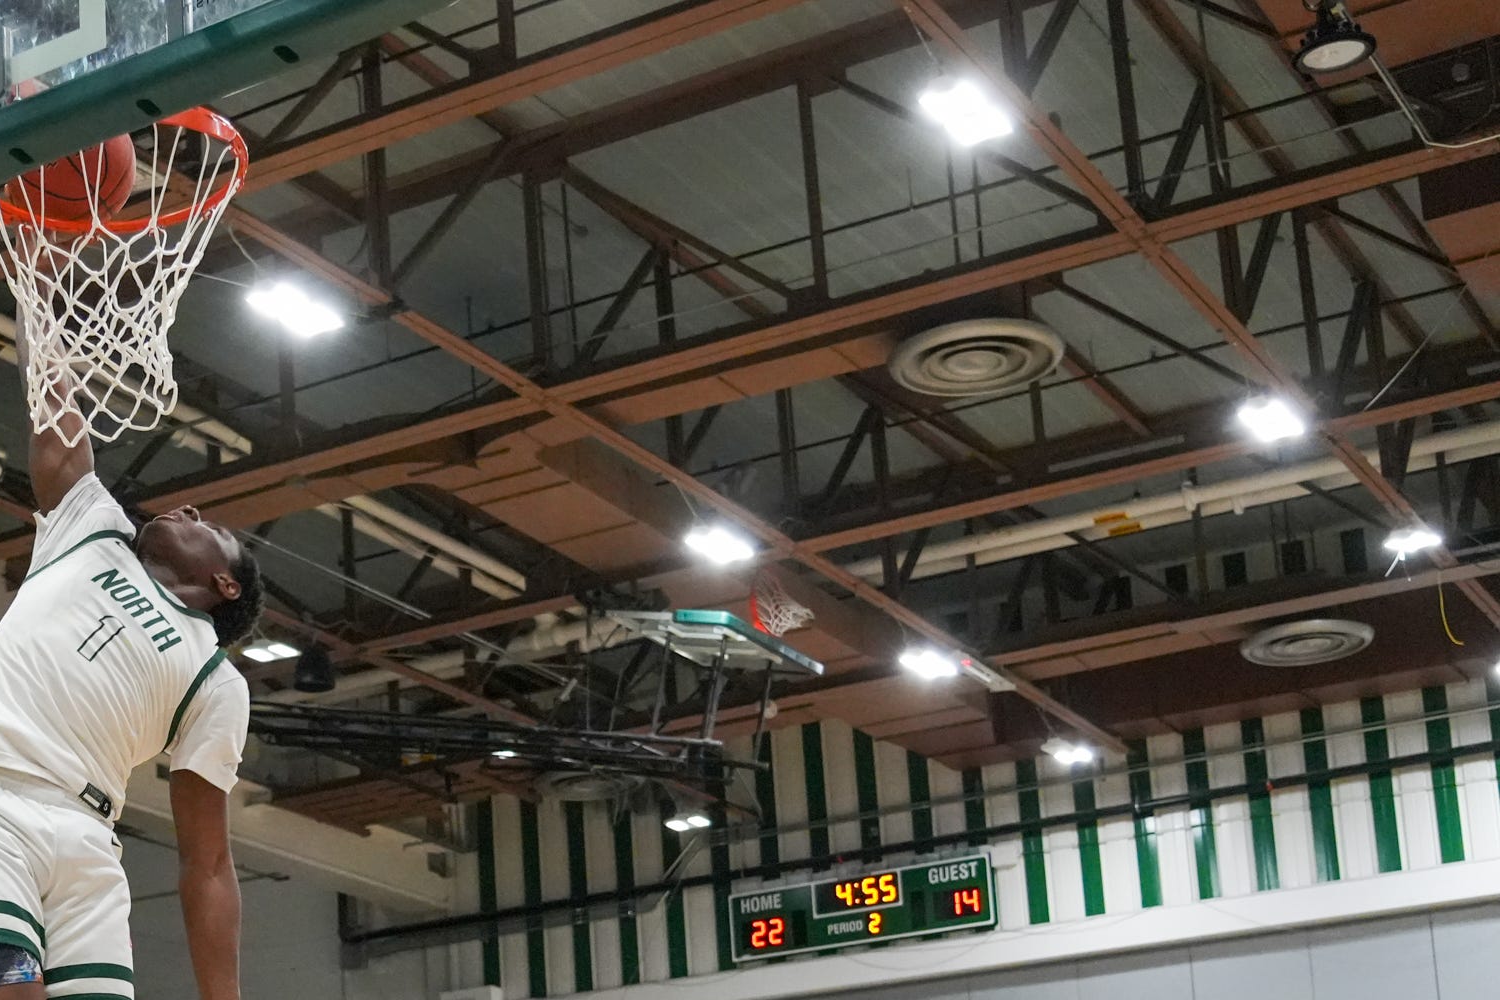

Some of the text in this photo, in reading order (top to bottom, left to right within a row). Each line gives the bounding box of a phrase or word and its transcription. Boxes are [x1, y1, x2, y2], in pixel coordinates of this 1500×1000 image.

[91, 568, 182, 653] NORTH
[77, 615, 126, 662] 1
[928, 861, 978, 884] GUEST
[740, 893, 782, 914] HOME
[835, 873, 897, 906] 4:55
[953, 888, 980, 916] 14
[751, 918, 783, 948] 22
[827, 912, 882, 936] PERIOD 2
